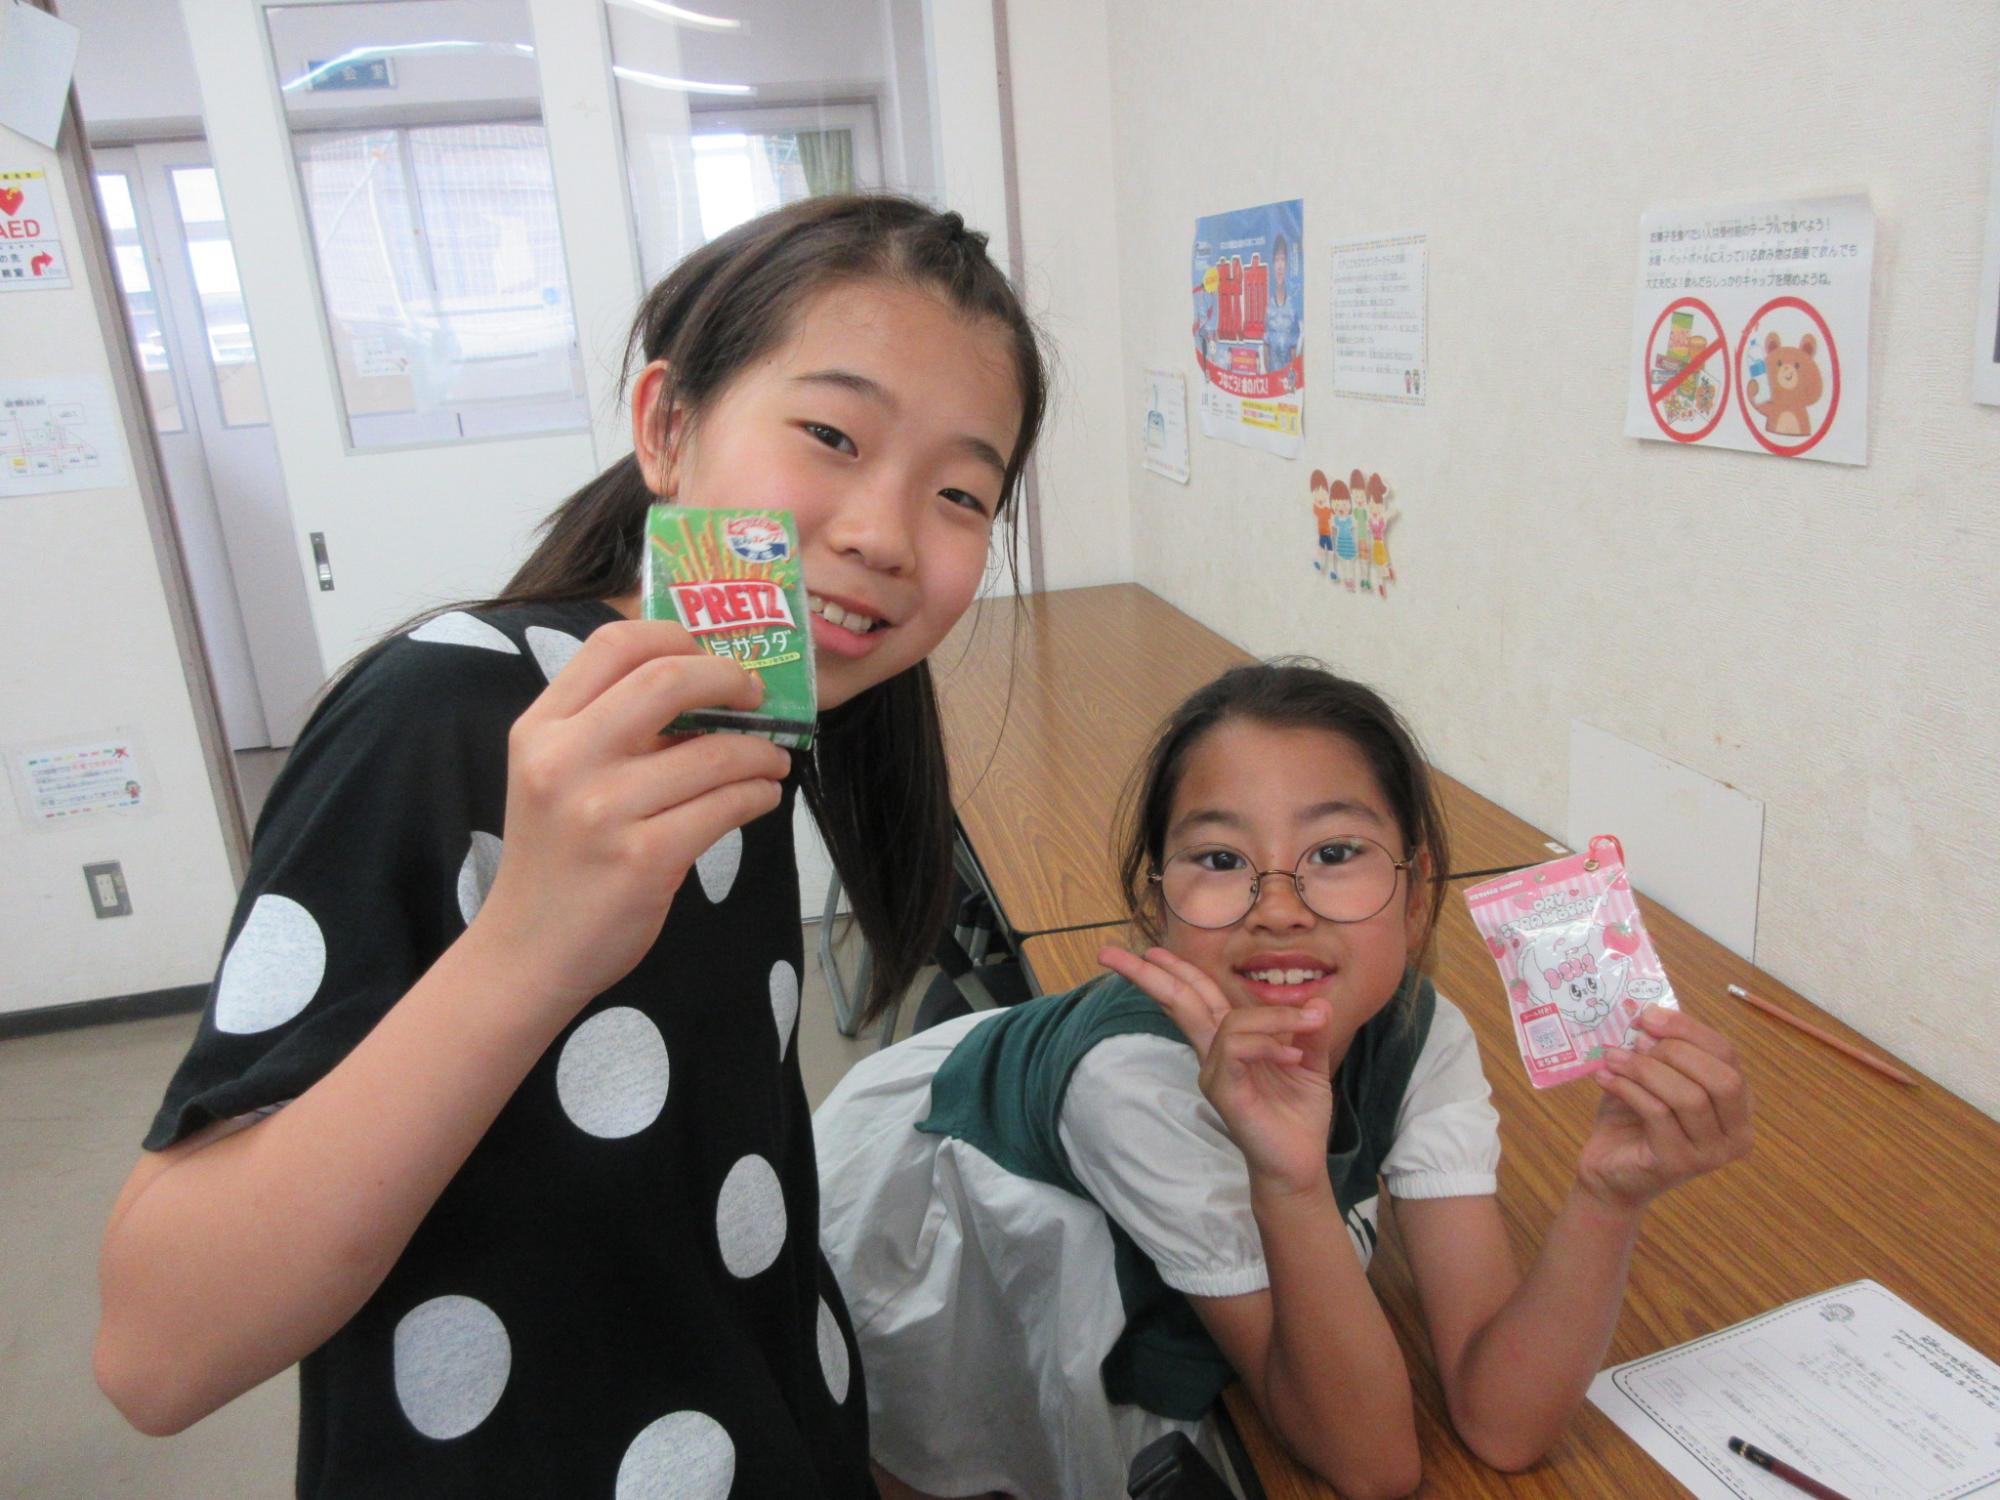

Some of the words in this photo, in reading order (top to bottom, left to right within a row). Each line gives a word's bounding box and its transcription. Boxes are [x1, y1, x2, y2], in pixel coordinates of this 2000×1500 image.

[677, 583, 786, 628] PRETZ
[710, 629, 792, 660] 旨サラダ
